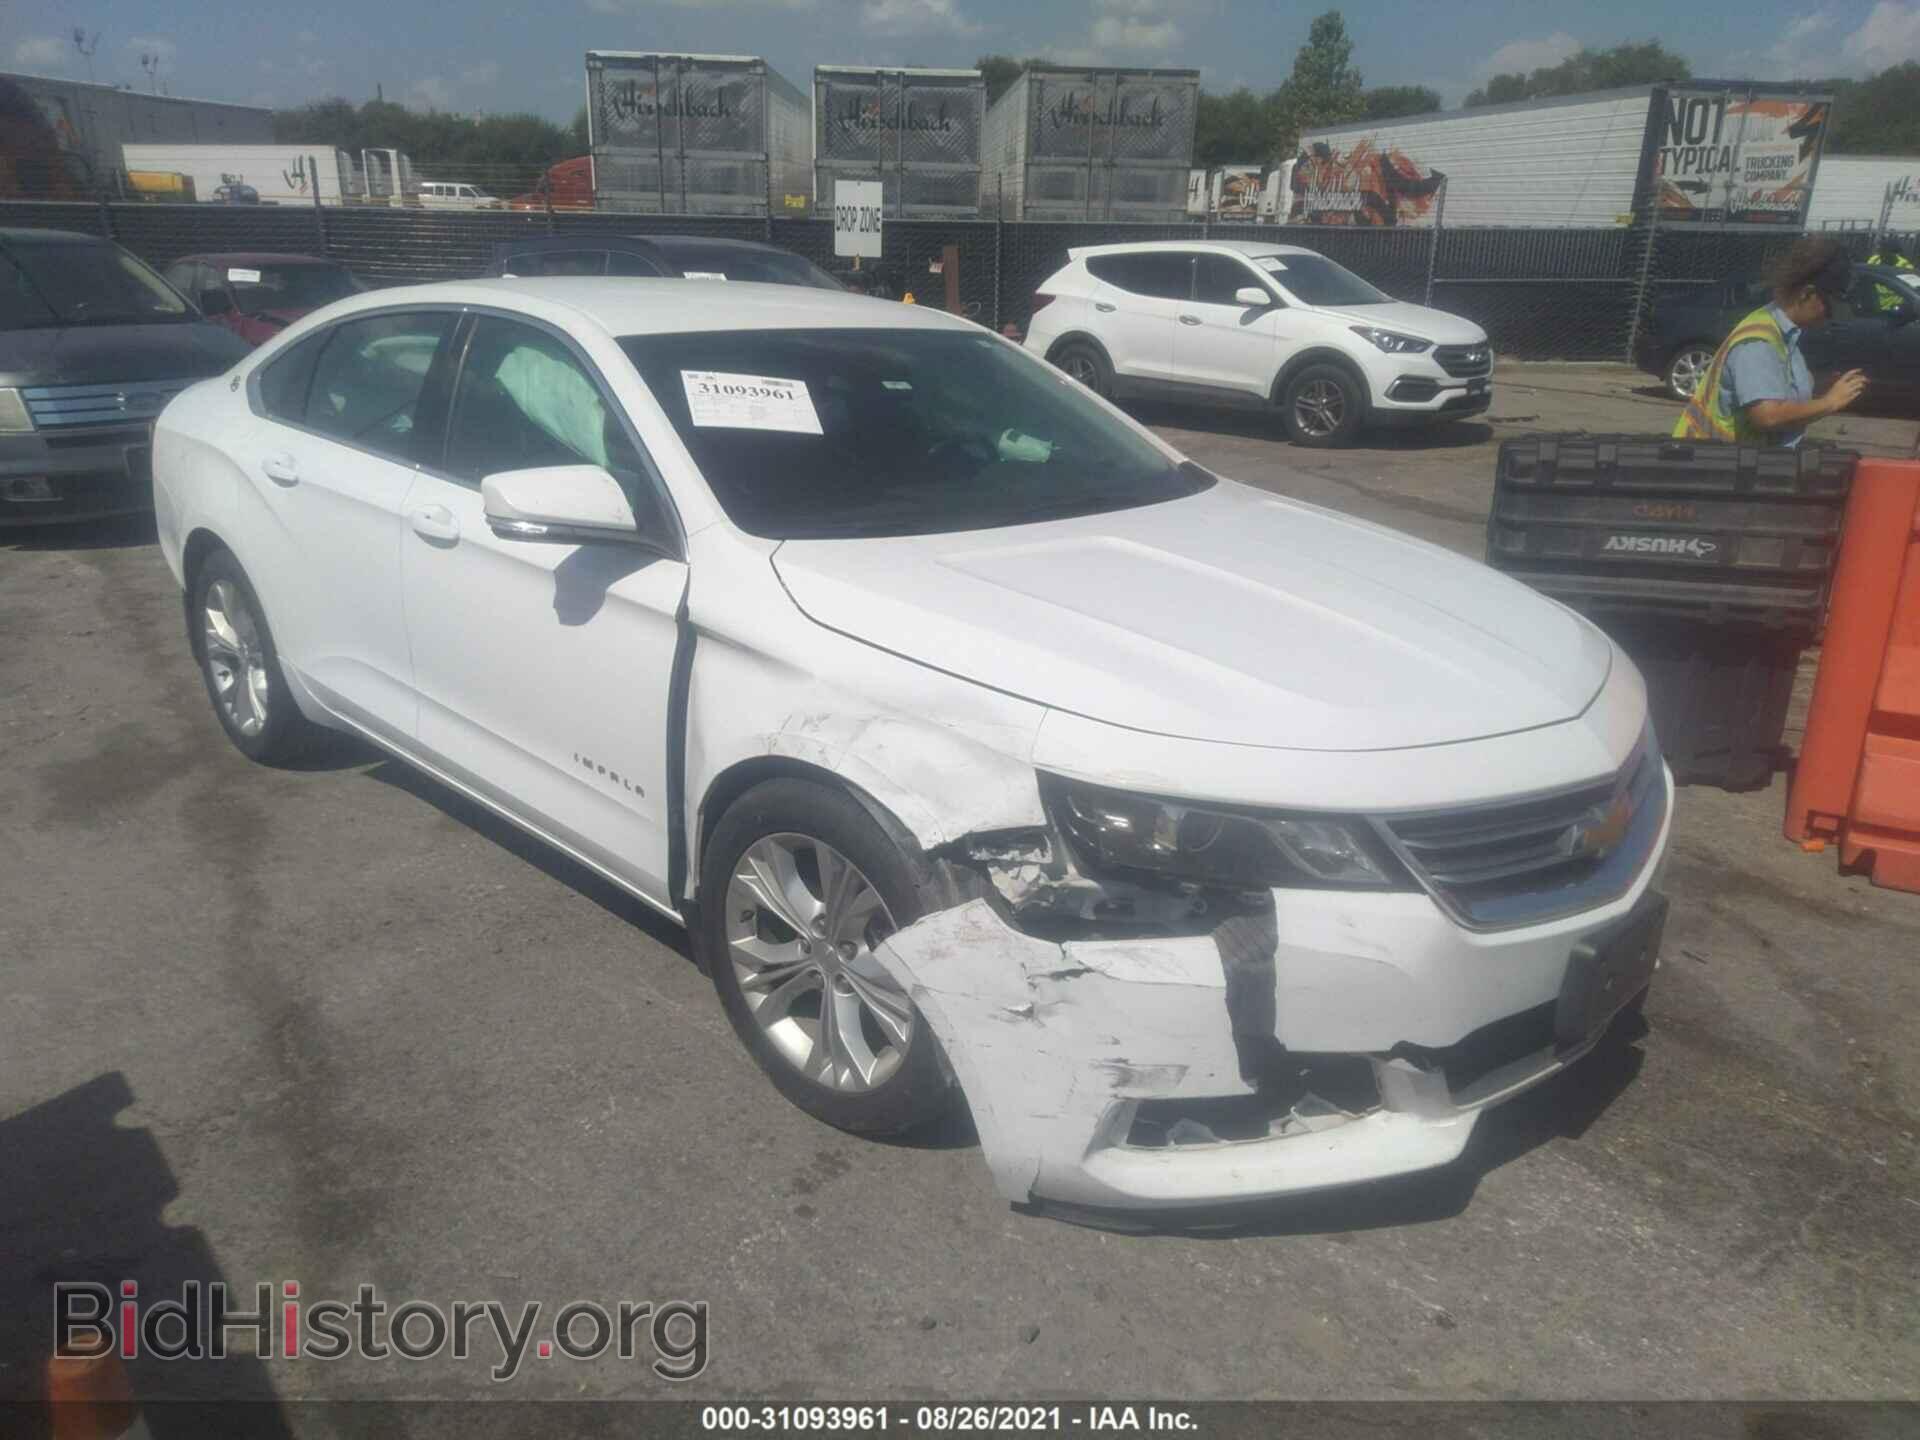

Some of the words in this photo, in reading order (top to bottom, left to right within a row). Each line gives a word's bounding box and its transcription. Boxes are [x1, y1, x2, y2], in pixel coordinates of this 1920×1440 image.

[612, 78, 732, 119] Hirschbach
[1663, 97, 1732, 146] NOT
[1744, 155, 1794, 170] TRUCKING
[836, 206, 858, 232] DROP
[860, 207, 880, 233] ZONE
[699, 383, 794, 400] 31093961
[1604, 535, 1688, 553] HUSKY
[573, 752, 645, 798] IMPALA
